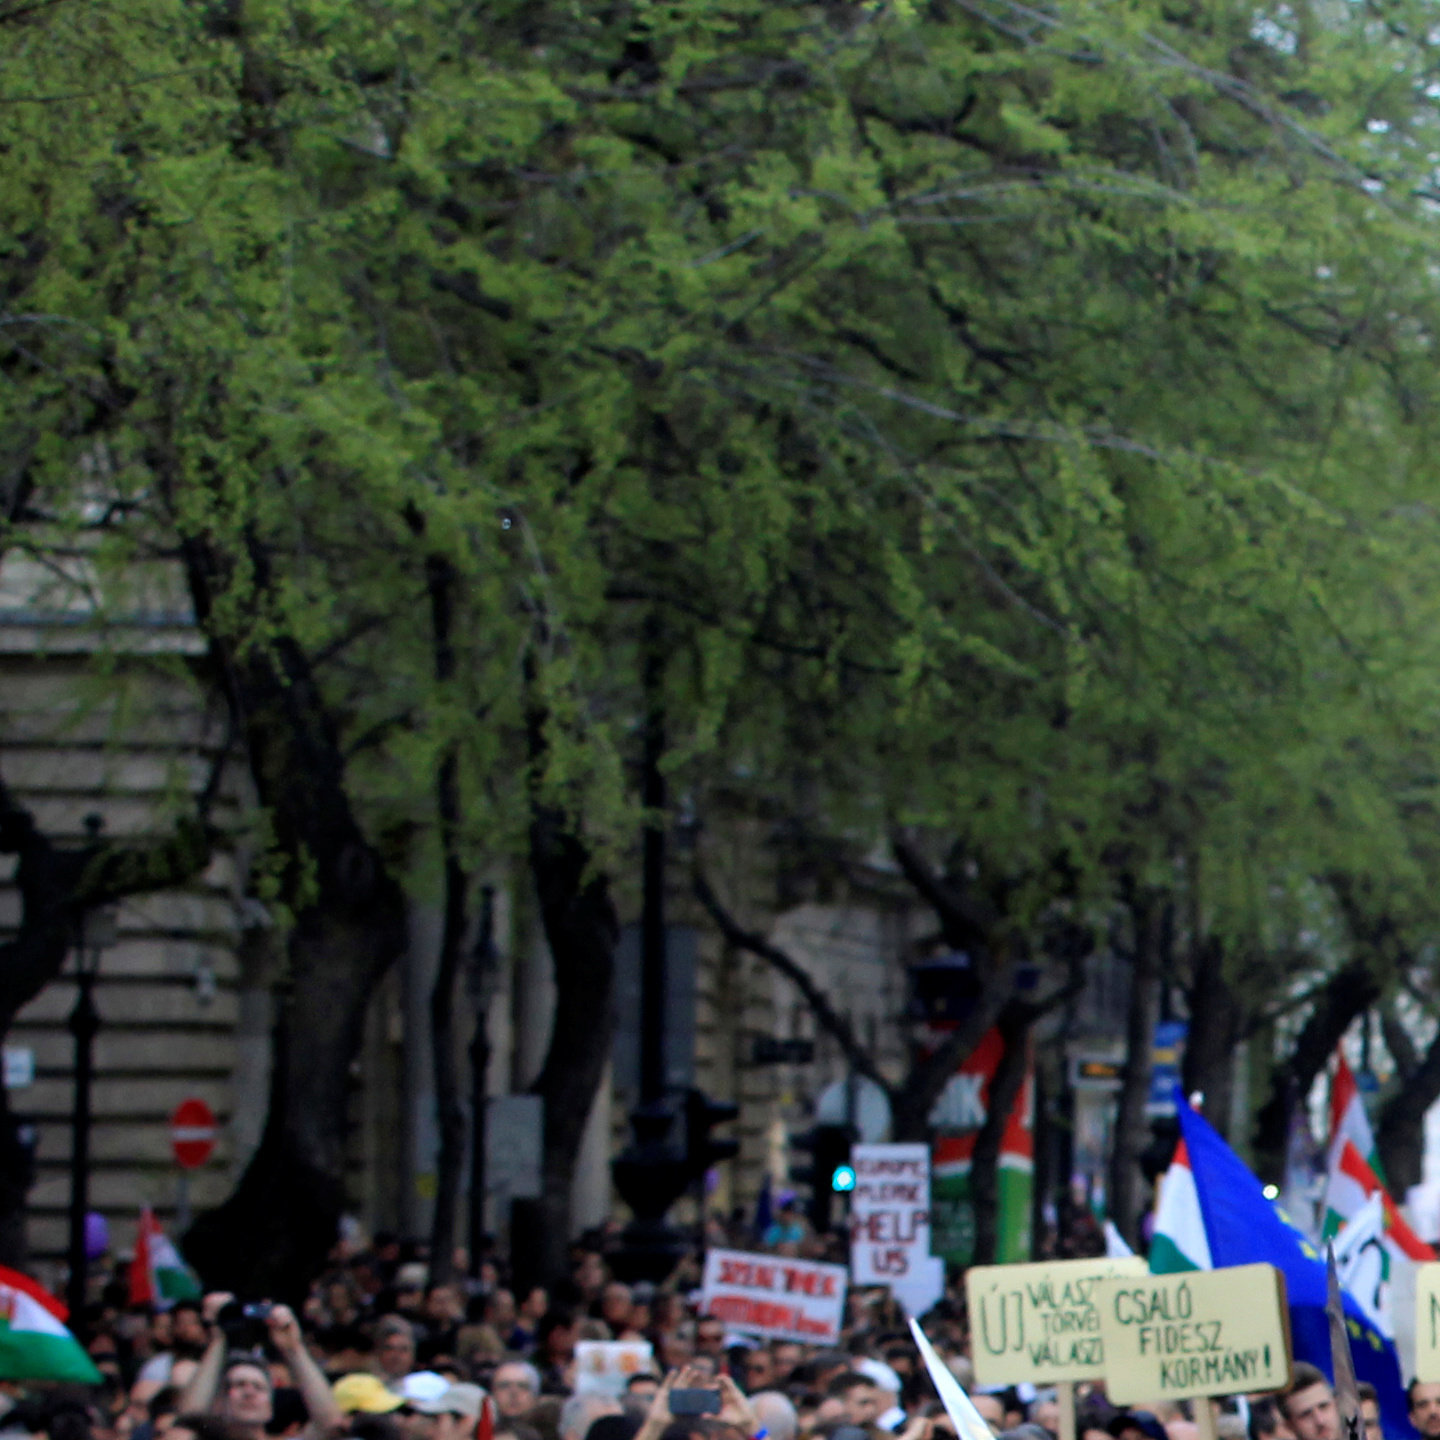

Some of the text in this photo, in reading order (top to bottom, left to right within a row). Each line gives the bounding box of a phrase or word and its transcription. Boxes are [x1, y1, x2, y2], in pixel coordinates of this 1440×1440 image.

[851, 1211, 929, 1244] HELP
[872, 1250, 909, 1275] US
[980, 1284, 1025, 1355] ÚJ
[1114, 1280, 1192, 1325] CSALÓ
[1139, 1321, 1224, 1355] FIDESZ
